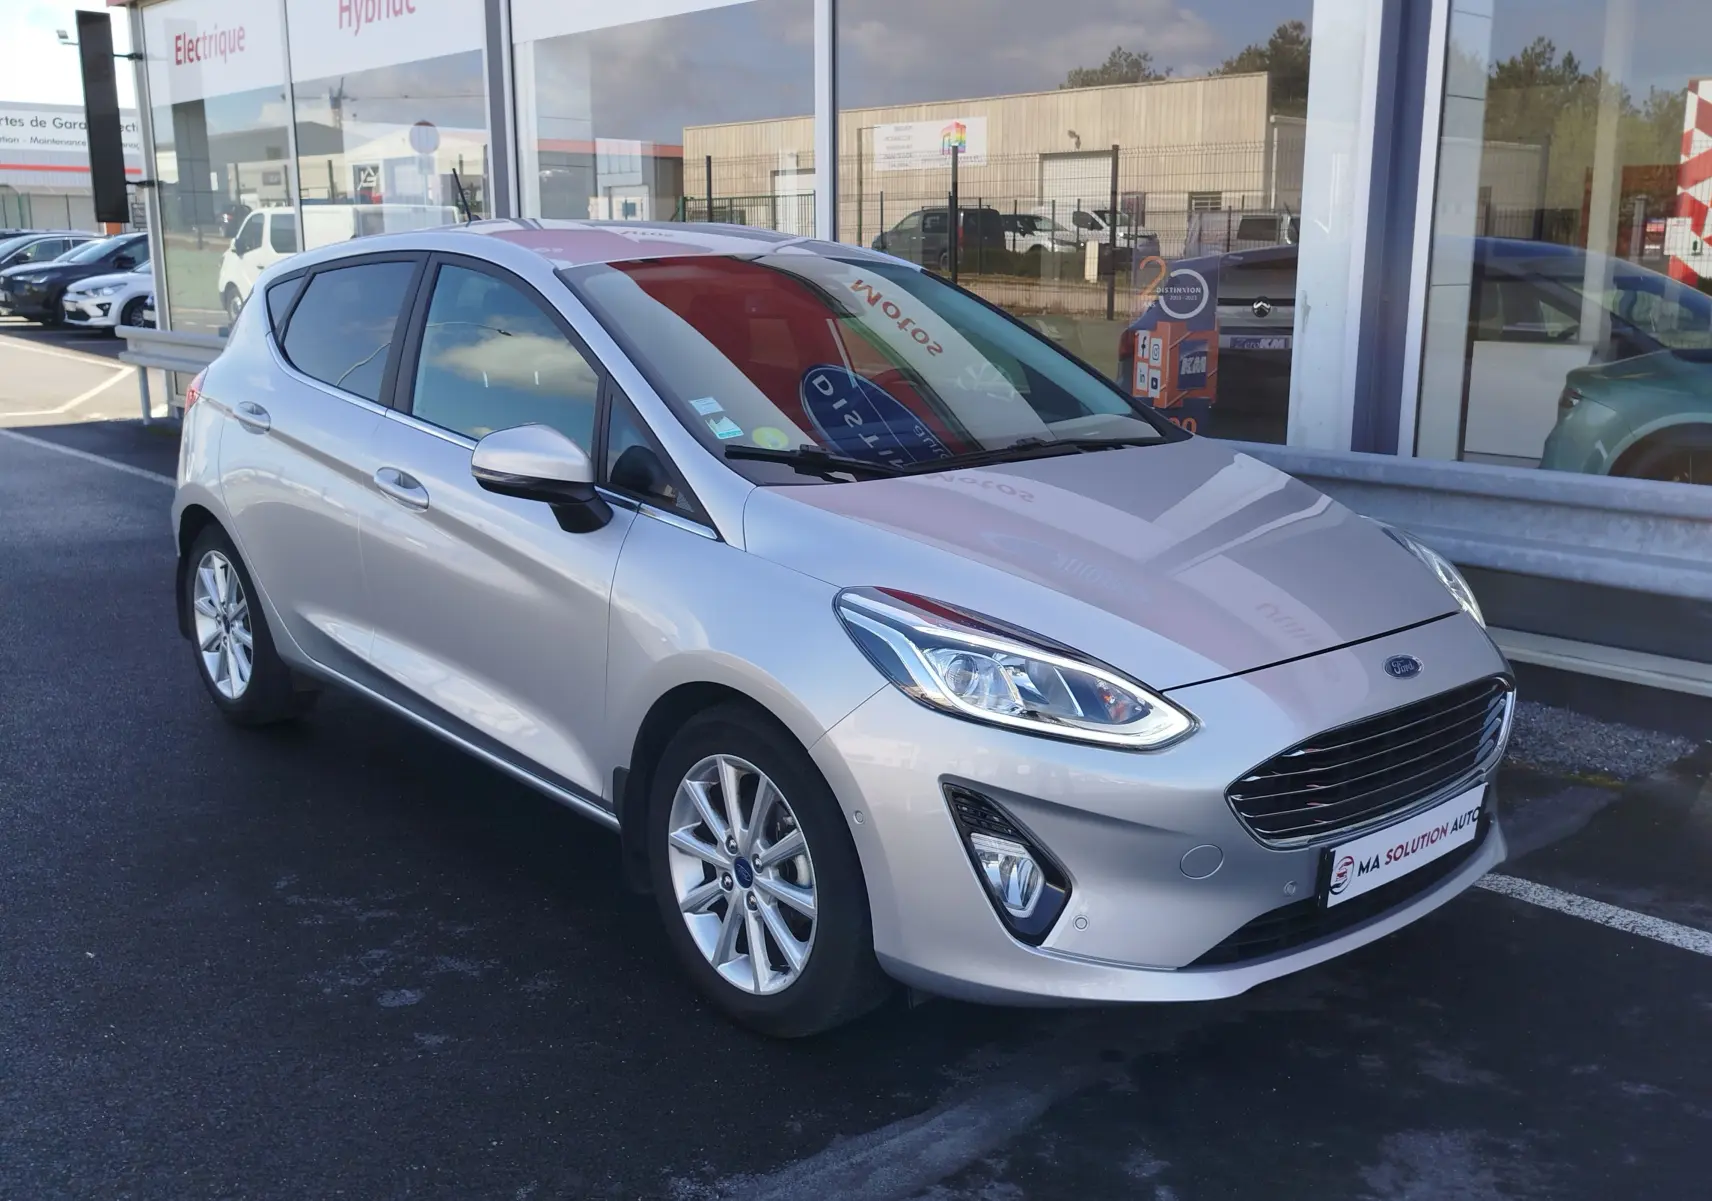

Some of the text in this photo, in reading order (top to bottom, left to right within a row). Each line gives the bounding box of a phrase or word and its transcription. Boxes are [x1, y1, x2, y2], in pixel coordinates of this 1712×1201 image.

[174, 23, 246, 66] Electrique
[30, 115, 48, 128] de
[1357, 853, 1380, 877] MA
[1384, 822, 1449, 865] SOLUTION
